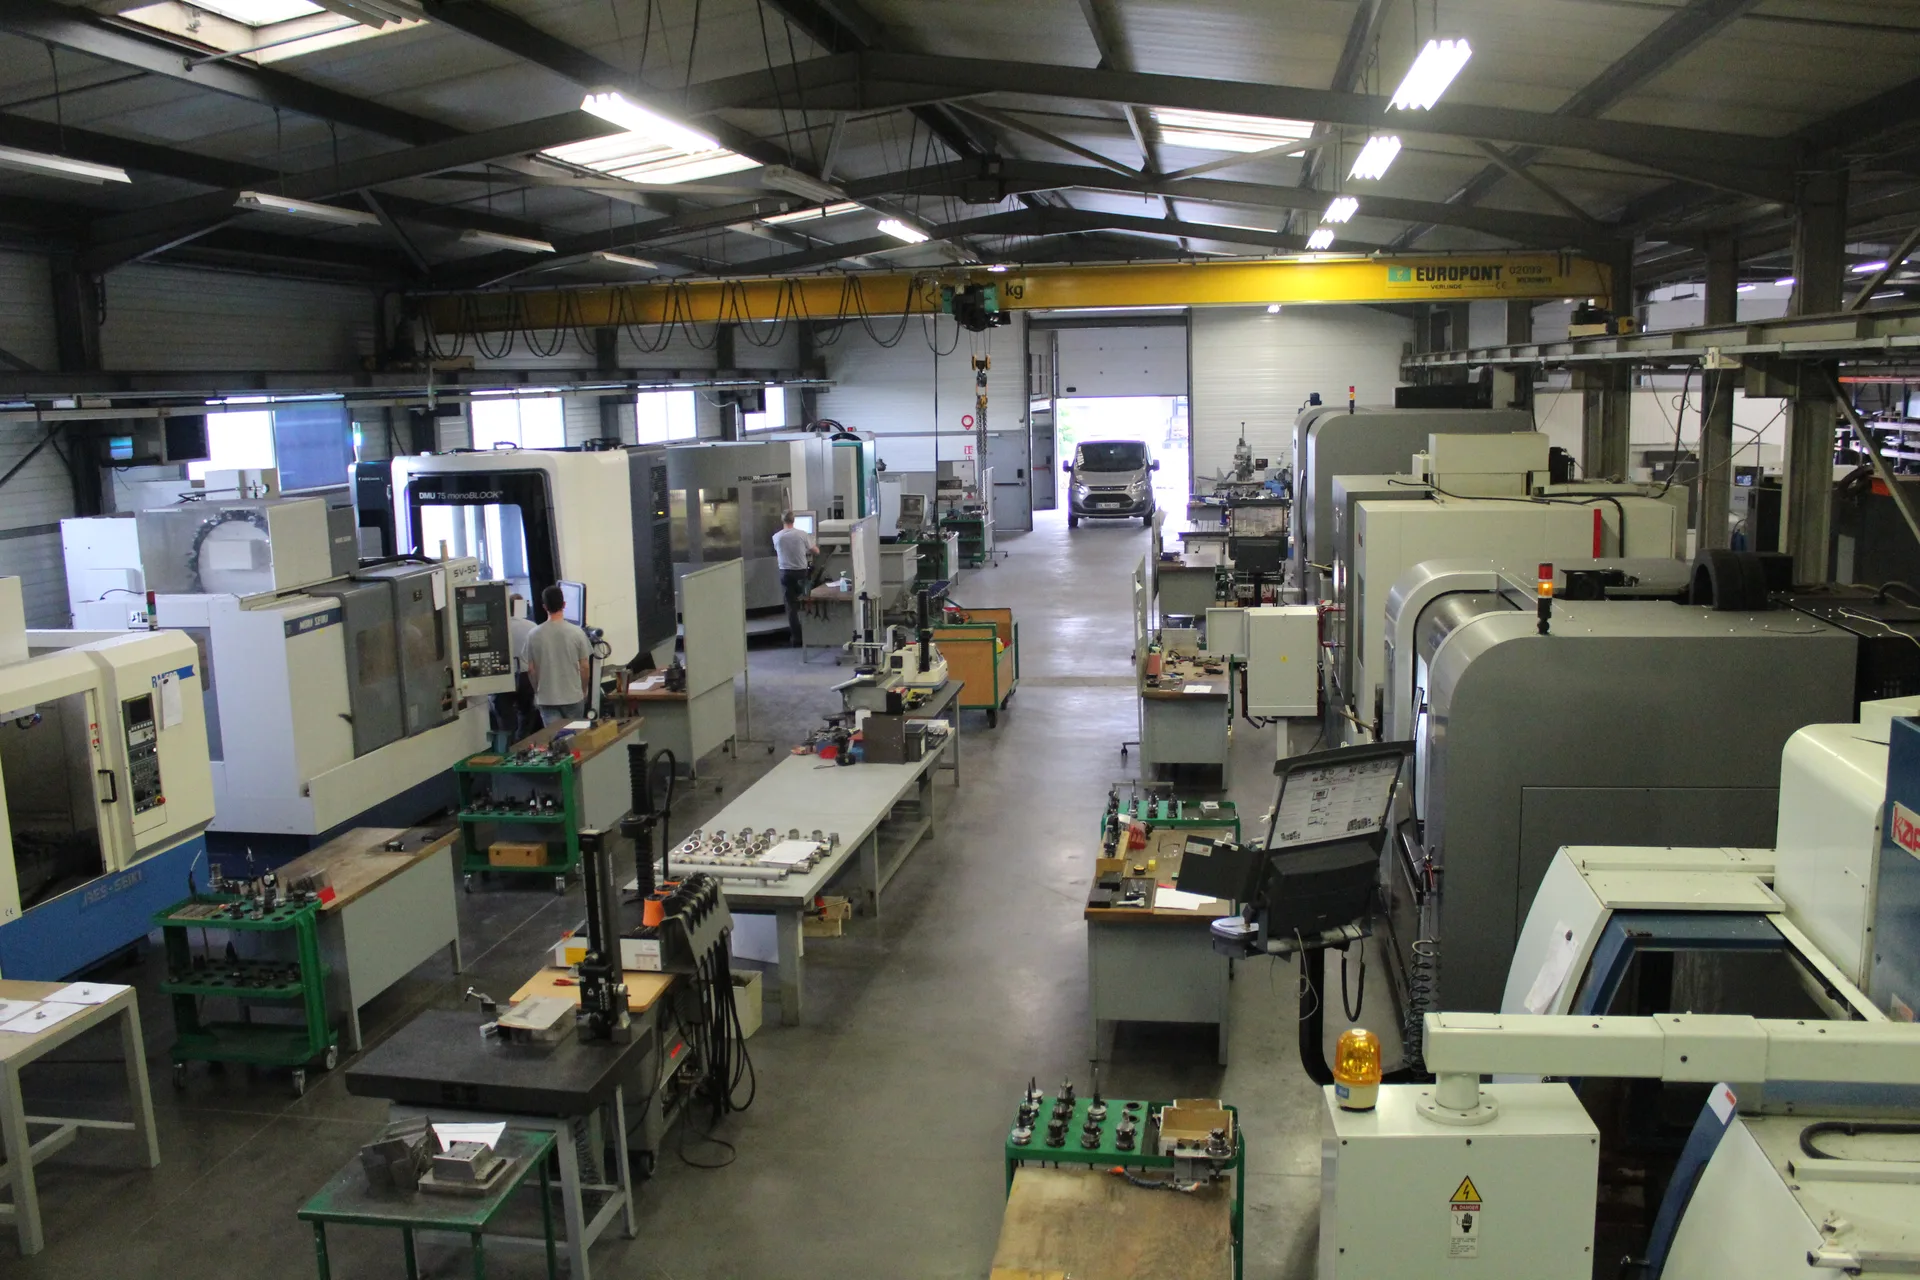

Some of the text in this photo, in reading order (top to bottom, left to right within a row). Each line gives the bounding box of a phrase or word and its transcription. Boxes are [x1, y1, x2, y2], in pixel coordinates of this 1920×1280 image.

[1416, 265, 1503, 281] EUROPONT
[1005, 282, 1024, 299] kg
[419, 492, 436, 500] DMU
[437, 492, 447, 500] 75
